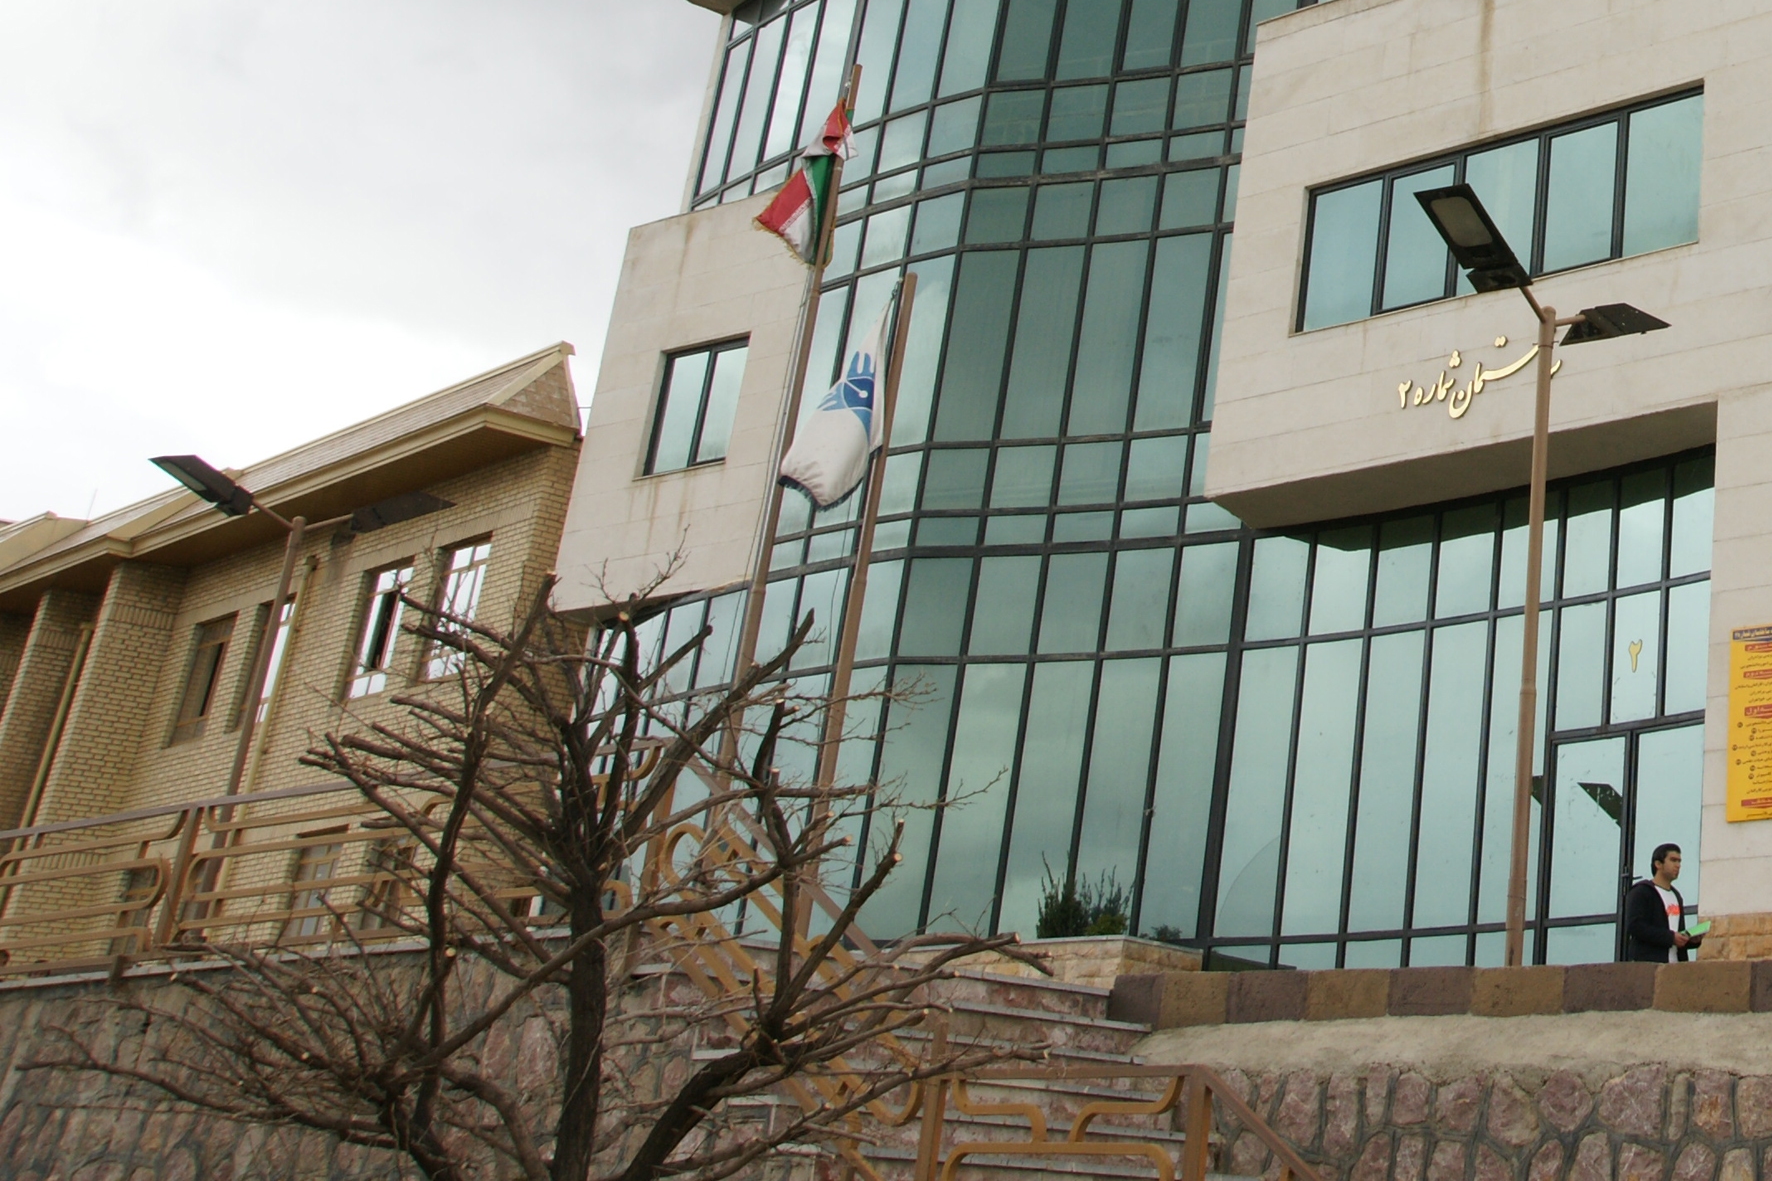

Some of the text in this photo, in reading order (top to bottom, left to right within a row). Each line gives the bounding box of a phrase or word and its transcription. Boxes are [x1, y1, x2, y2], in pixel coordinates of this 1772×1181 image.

[1398, 379, 1413, 409] ۲
[1413, 349, 1462, 406] شماره
[1628, 638, 1643, 673] ۲
